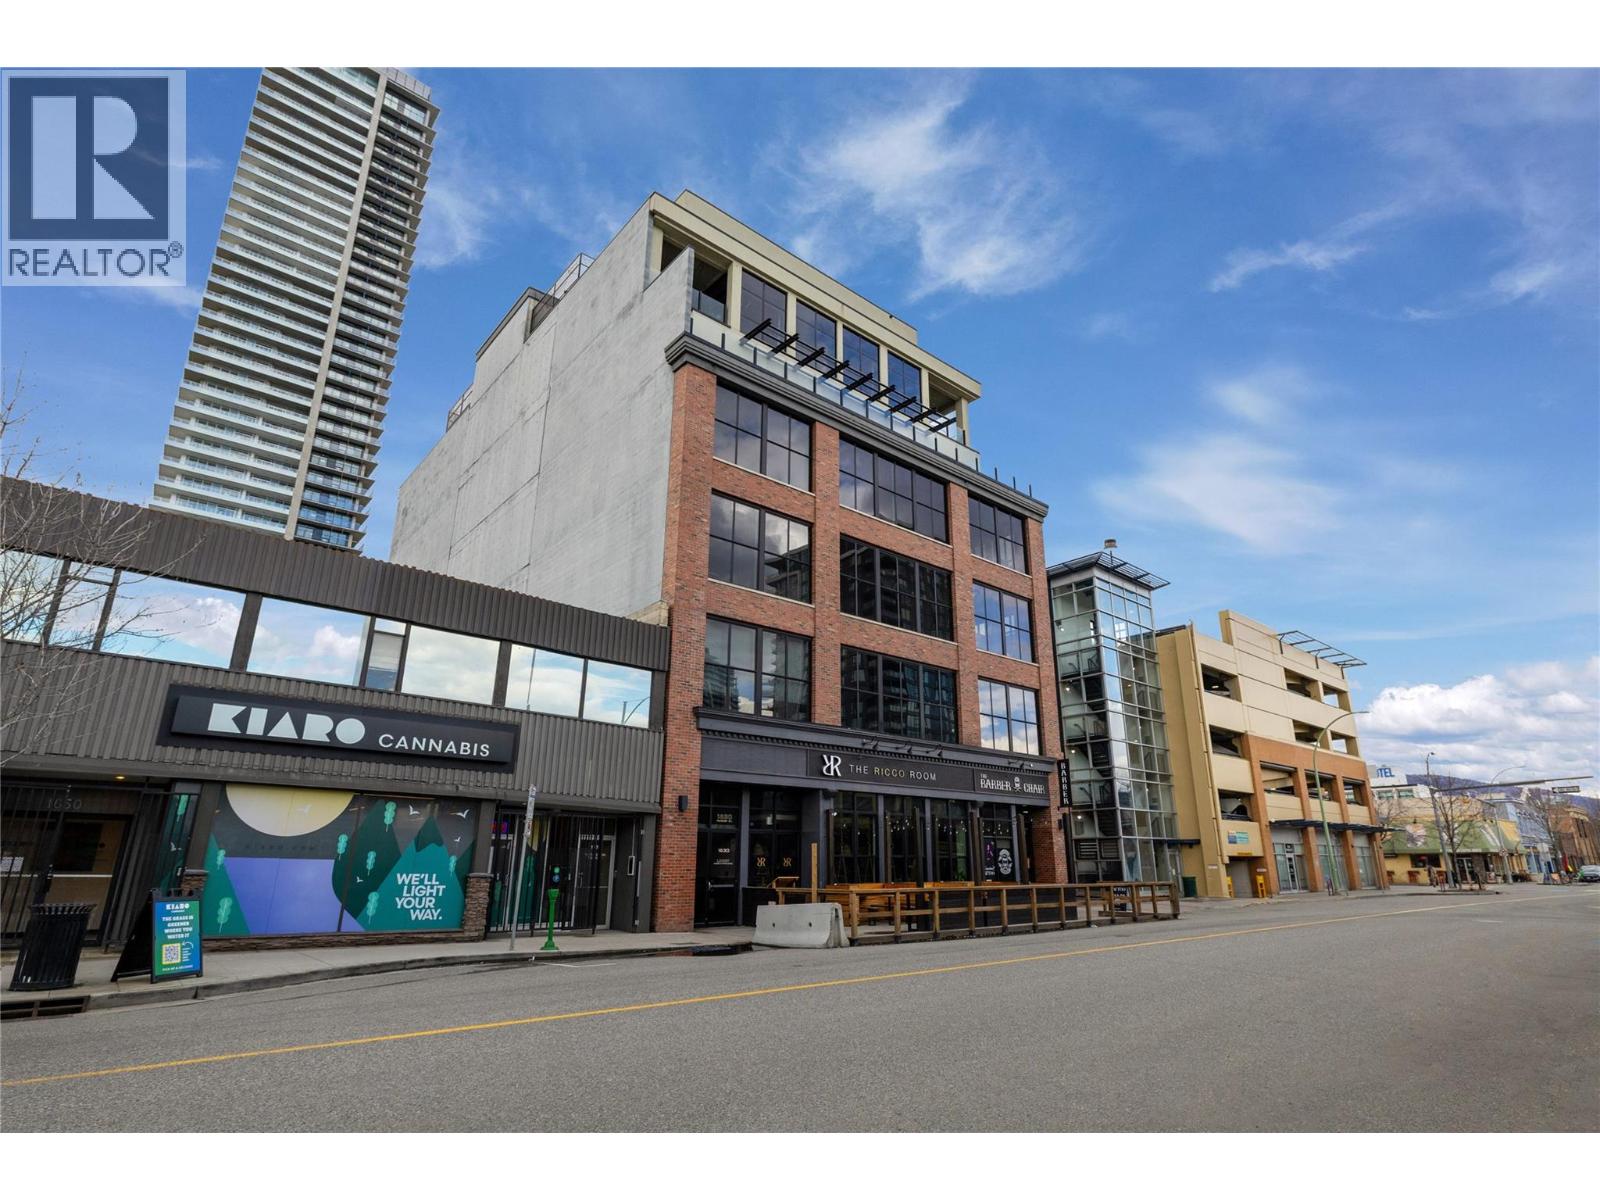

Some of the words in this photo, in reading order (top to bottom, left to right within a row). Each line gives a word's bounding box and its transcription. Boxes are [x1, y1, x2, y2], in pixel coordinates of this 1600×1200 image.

[207, 703, 366, 744] KIARO
[378, 734, 491, 757] CANNABIS
[849, 764, 869, 775] THE
[909, 770, 937, 781] ROOM
[980, 779, 1012, 791] BARBER
[1023, 783, 1046, 794] CHAIR
[1060, 762, 1069, 805] BARBER
[403, 885, 446, 897] LIGHT
[395, 897, 435, 909] YOUR
[410, 908, 442, 920] WAY.
